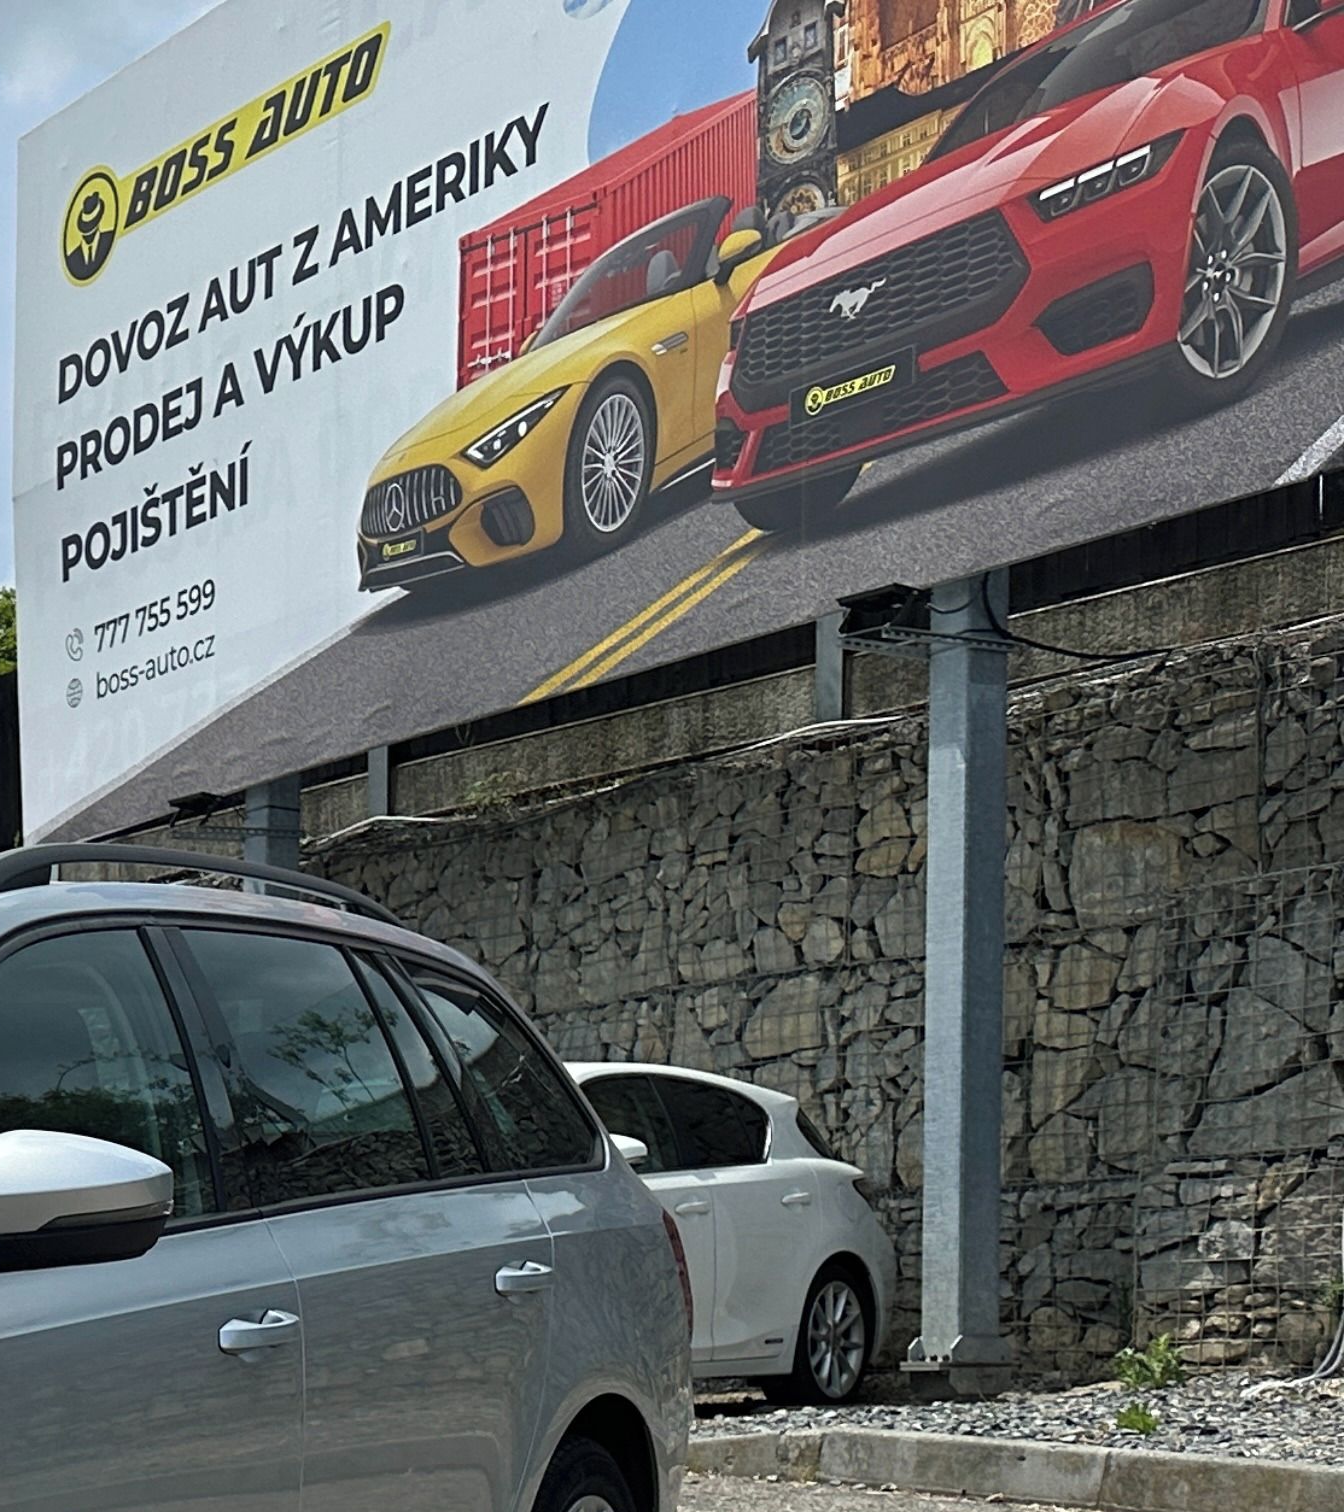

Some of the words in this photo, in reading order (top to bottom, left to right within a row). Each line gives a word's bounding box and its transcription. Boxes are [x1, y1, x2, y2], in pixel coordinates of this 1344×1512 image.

[124, 119, 236, 230] BOSS
[246, 33, 383, 160] AUTO
[58, 293, 190, 404] DOVOZ
[198, 244, 283, 333] AUT
[293, 224, 320, 286] Z
[329, 102, 550, 268] AMERIKY
[56, 377, 204, 490] PRODEJ
[214, 361, 245, 418] A
[254, 283, 405, 395] VÝKUP
[825, 381, 855, 402] BOSS
[858, 368, 892, 390] AUTO
[61, 441, 252, 582] POJIŠTĚNÍ
[94, 613, 130, 652] 777
[136, 596, 171, 638] 755
[176, 579, 216, 621] 599
[96, 635, 215, 699] boss-auto.cz
